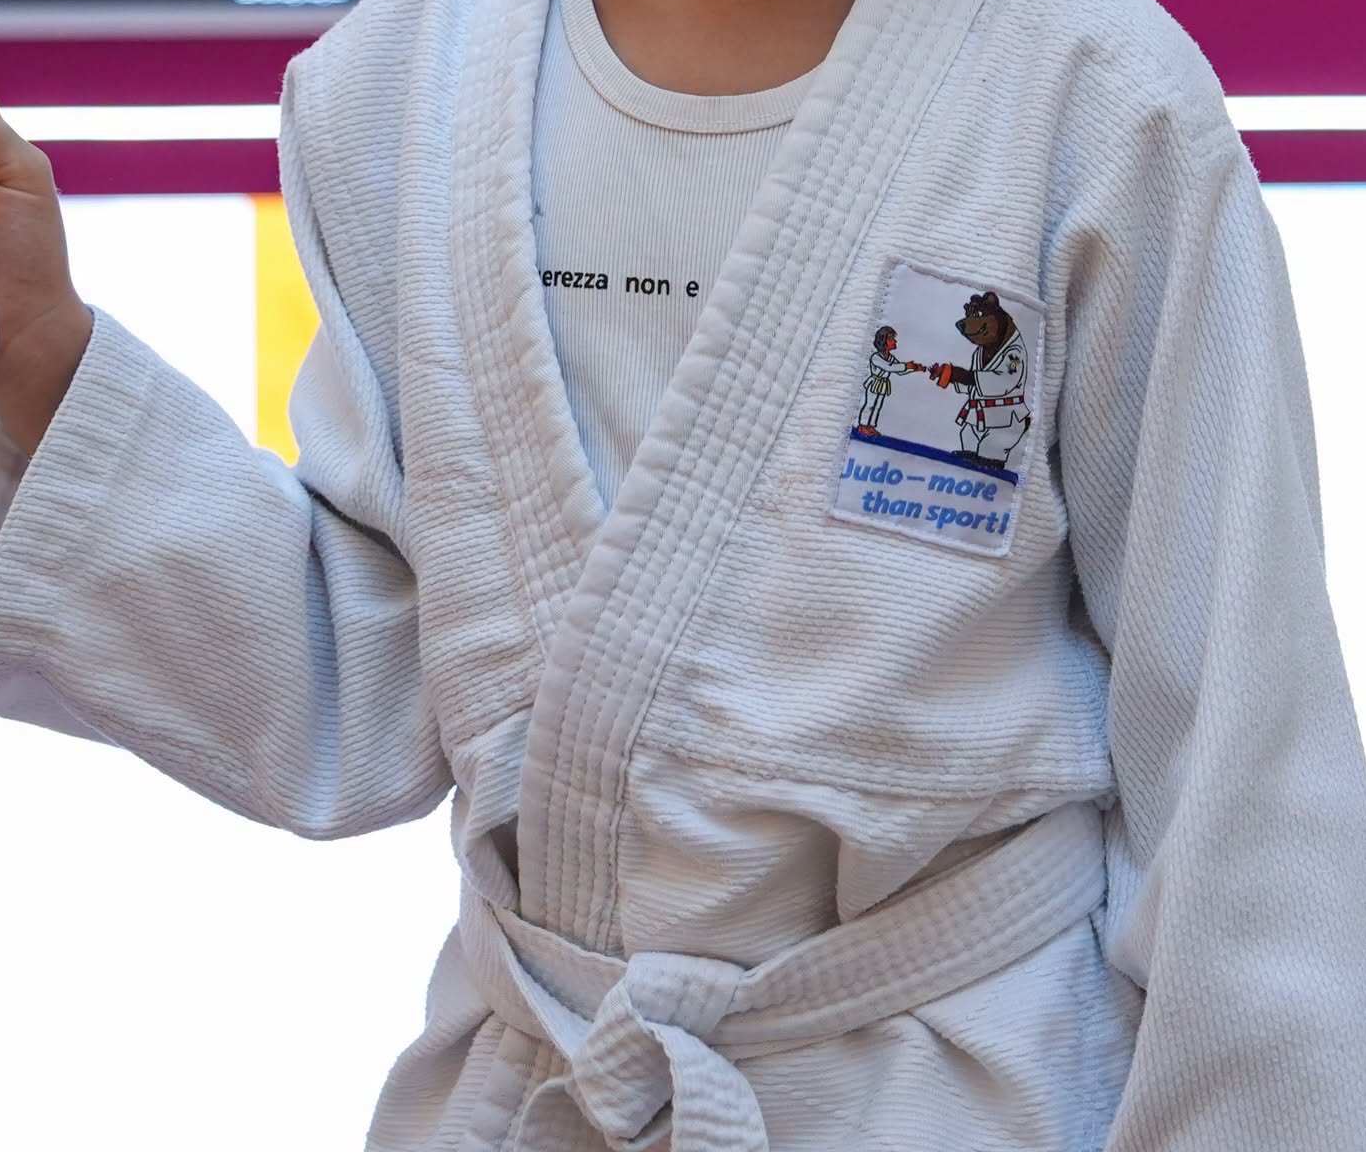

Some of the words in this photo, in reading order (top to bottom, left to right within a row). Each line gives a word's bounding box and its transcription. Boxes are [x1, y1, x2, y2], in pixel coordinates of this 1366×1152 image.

[539, 269, 608, 290] erezza
[625, 276, 670, 296] non
[686, 280, 699, 298] e
[842, 458, 904, 485] Judo
[928, 474, 998, 502] more
[862, 491, 923, 519] than
[925, 505, 1011, 535] sport!
